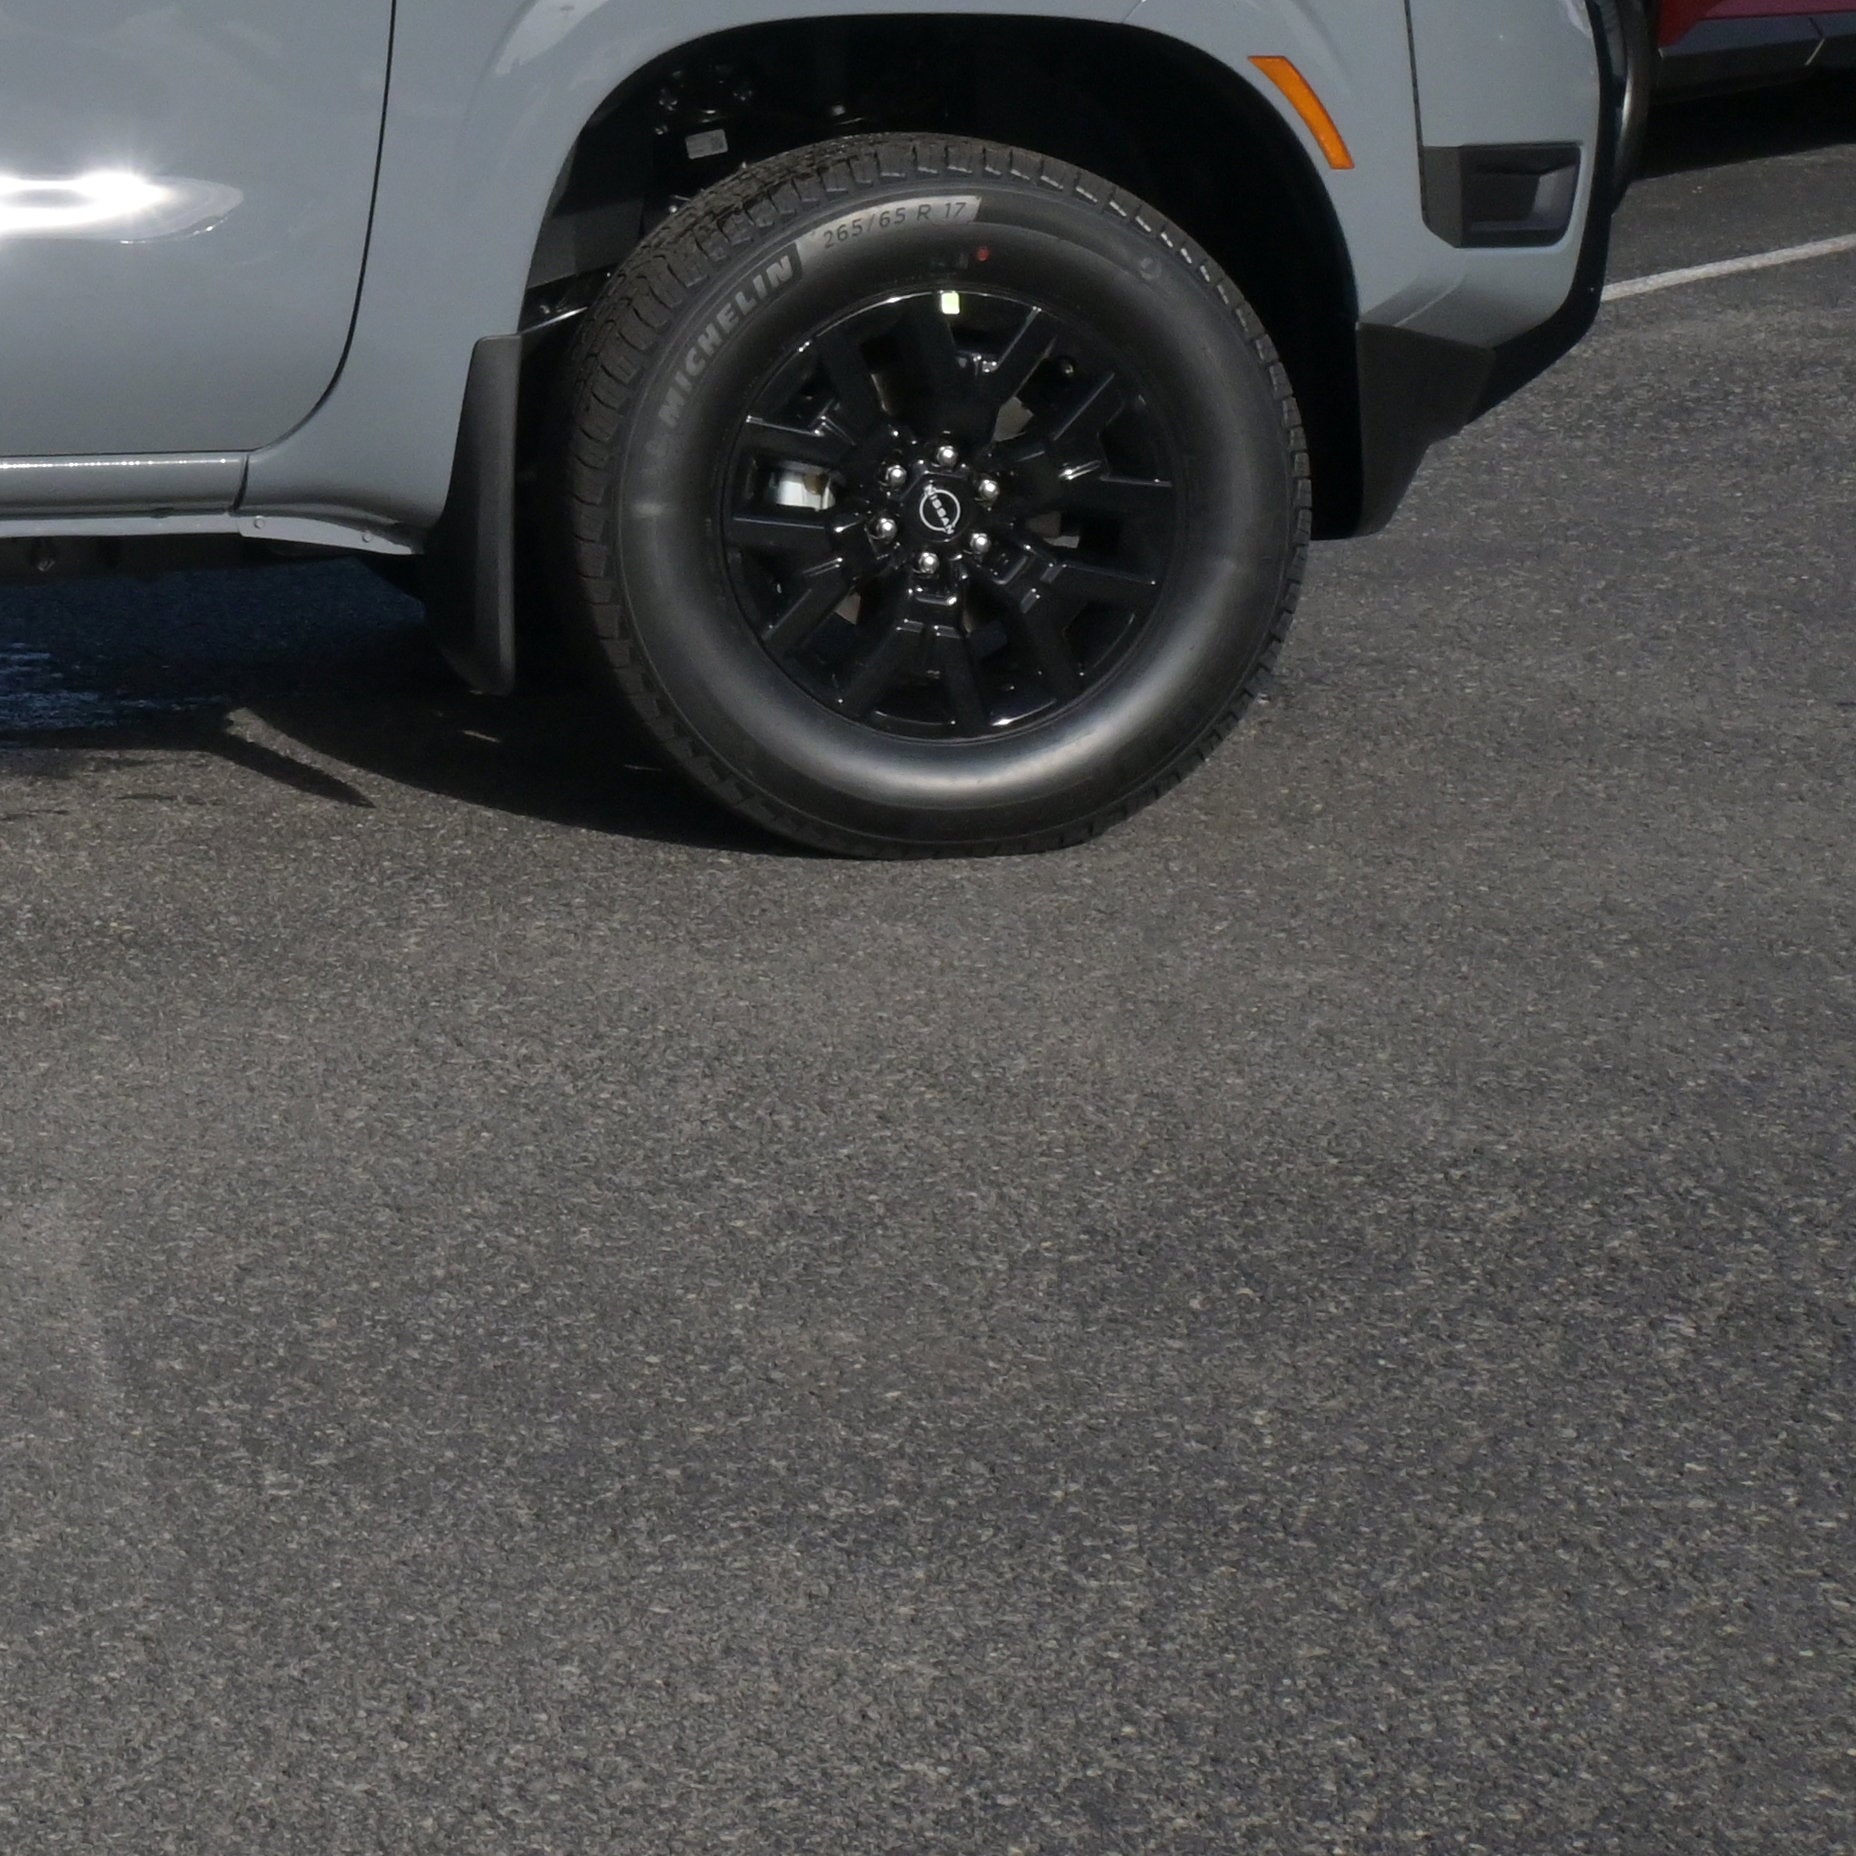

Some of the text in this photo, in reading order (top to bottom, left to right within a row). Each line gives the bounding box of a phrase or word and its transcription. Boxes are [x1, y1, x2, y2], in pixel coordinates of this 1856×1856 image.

[917, 203, 932, 221] R
[944, 202, 967, 220] 17
[658, 255, 793, 427] MICHELIN
[923, 484, 955, 534] NISSAN
